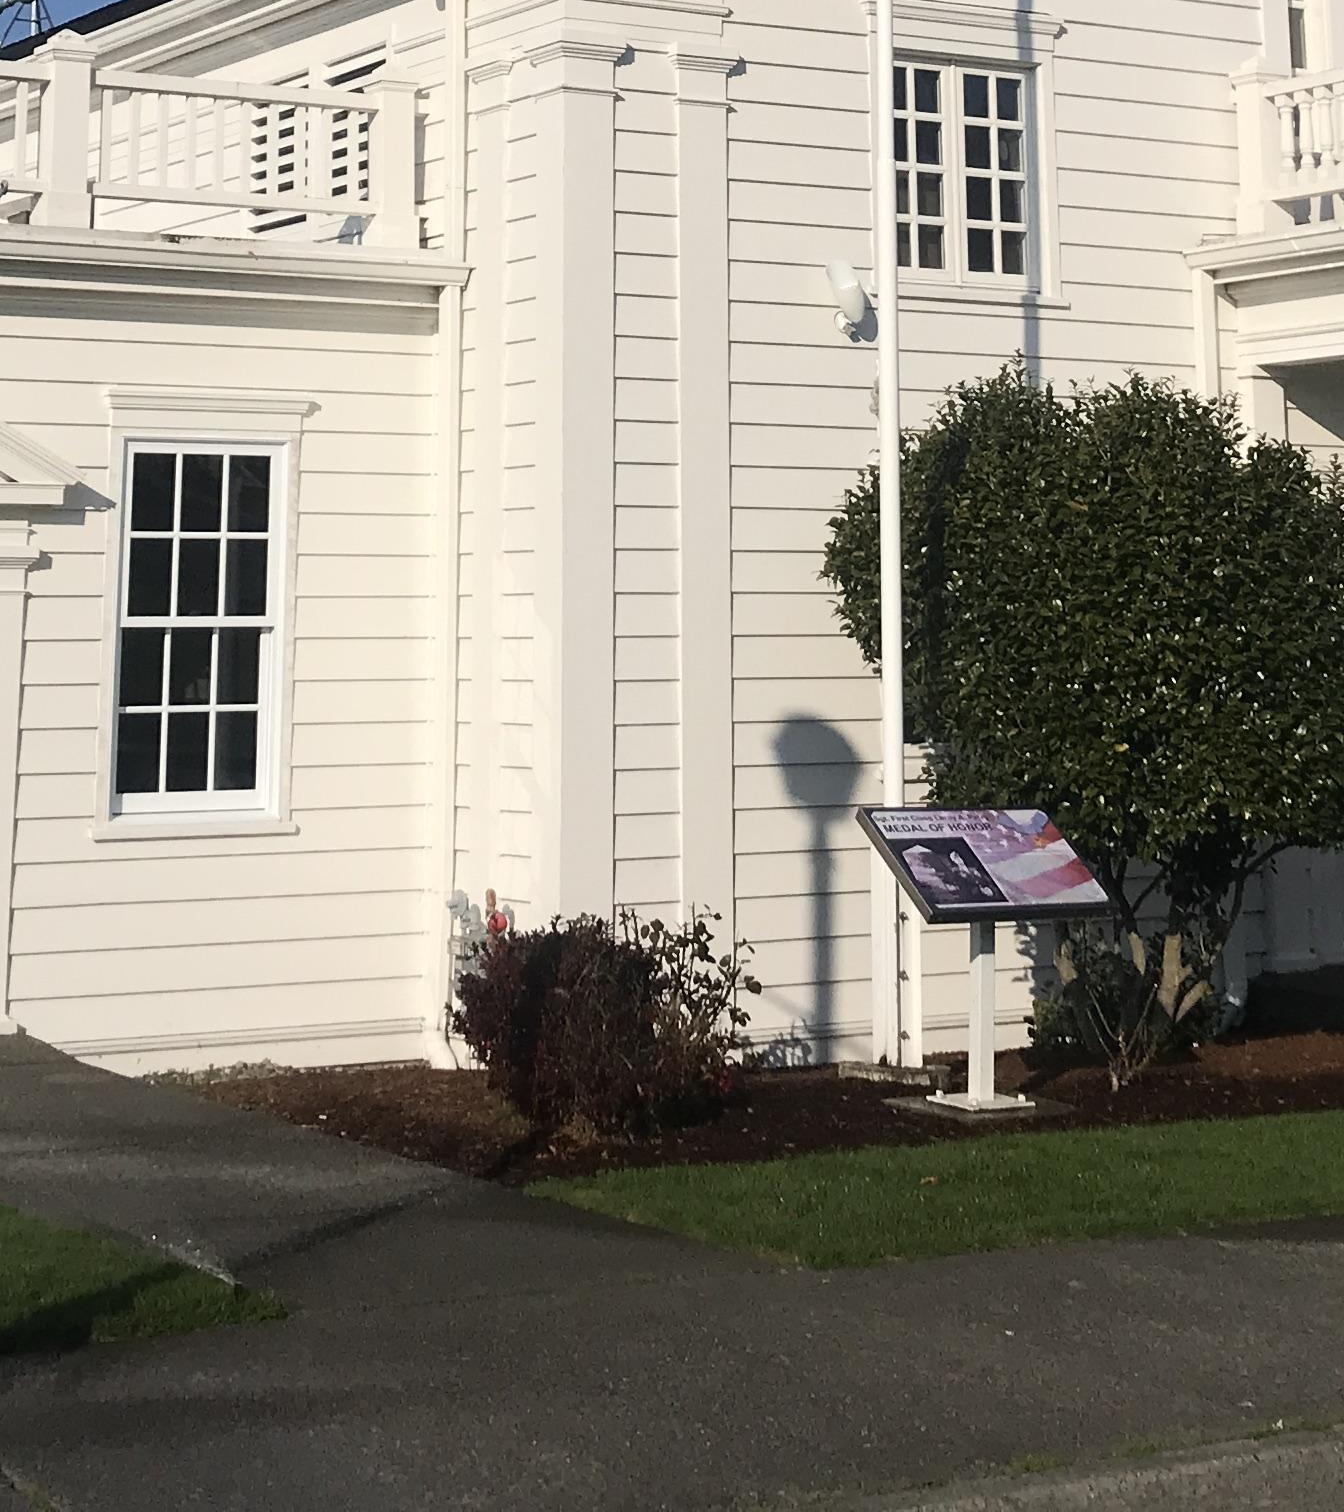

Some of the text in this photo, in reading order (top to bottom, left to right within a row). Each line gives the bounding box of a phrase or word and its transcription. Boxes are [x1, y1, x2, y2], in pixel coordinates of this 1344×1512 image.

[882, 822, 993, 833] MEDAL OF HONOR
